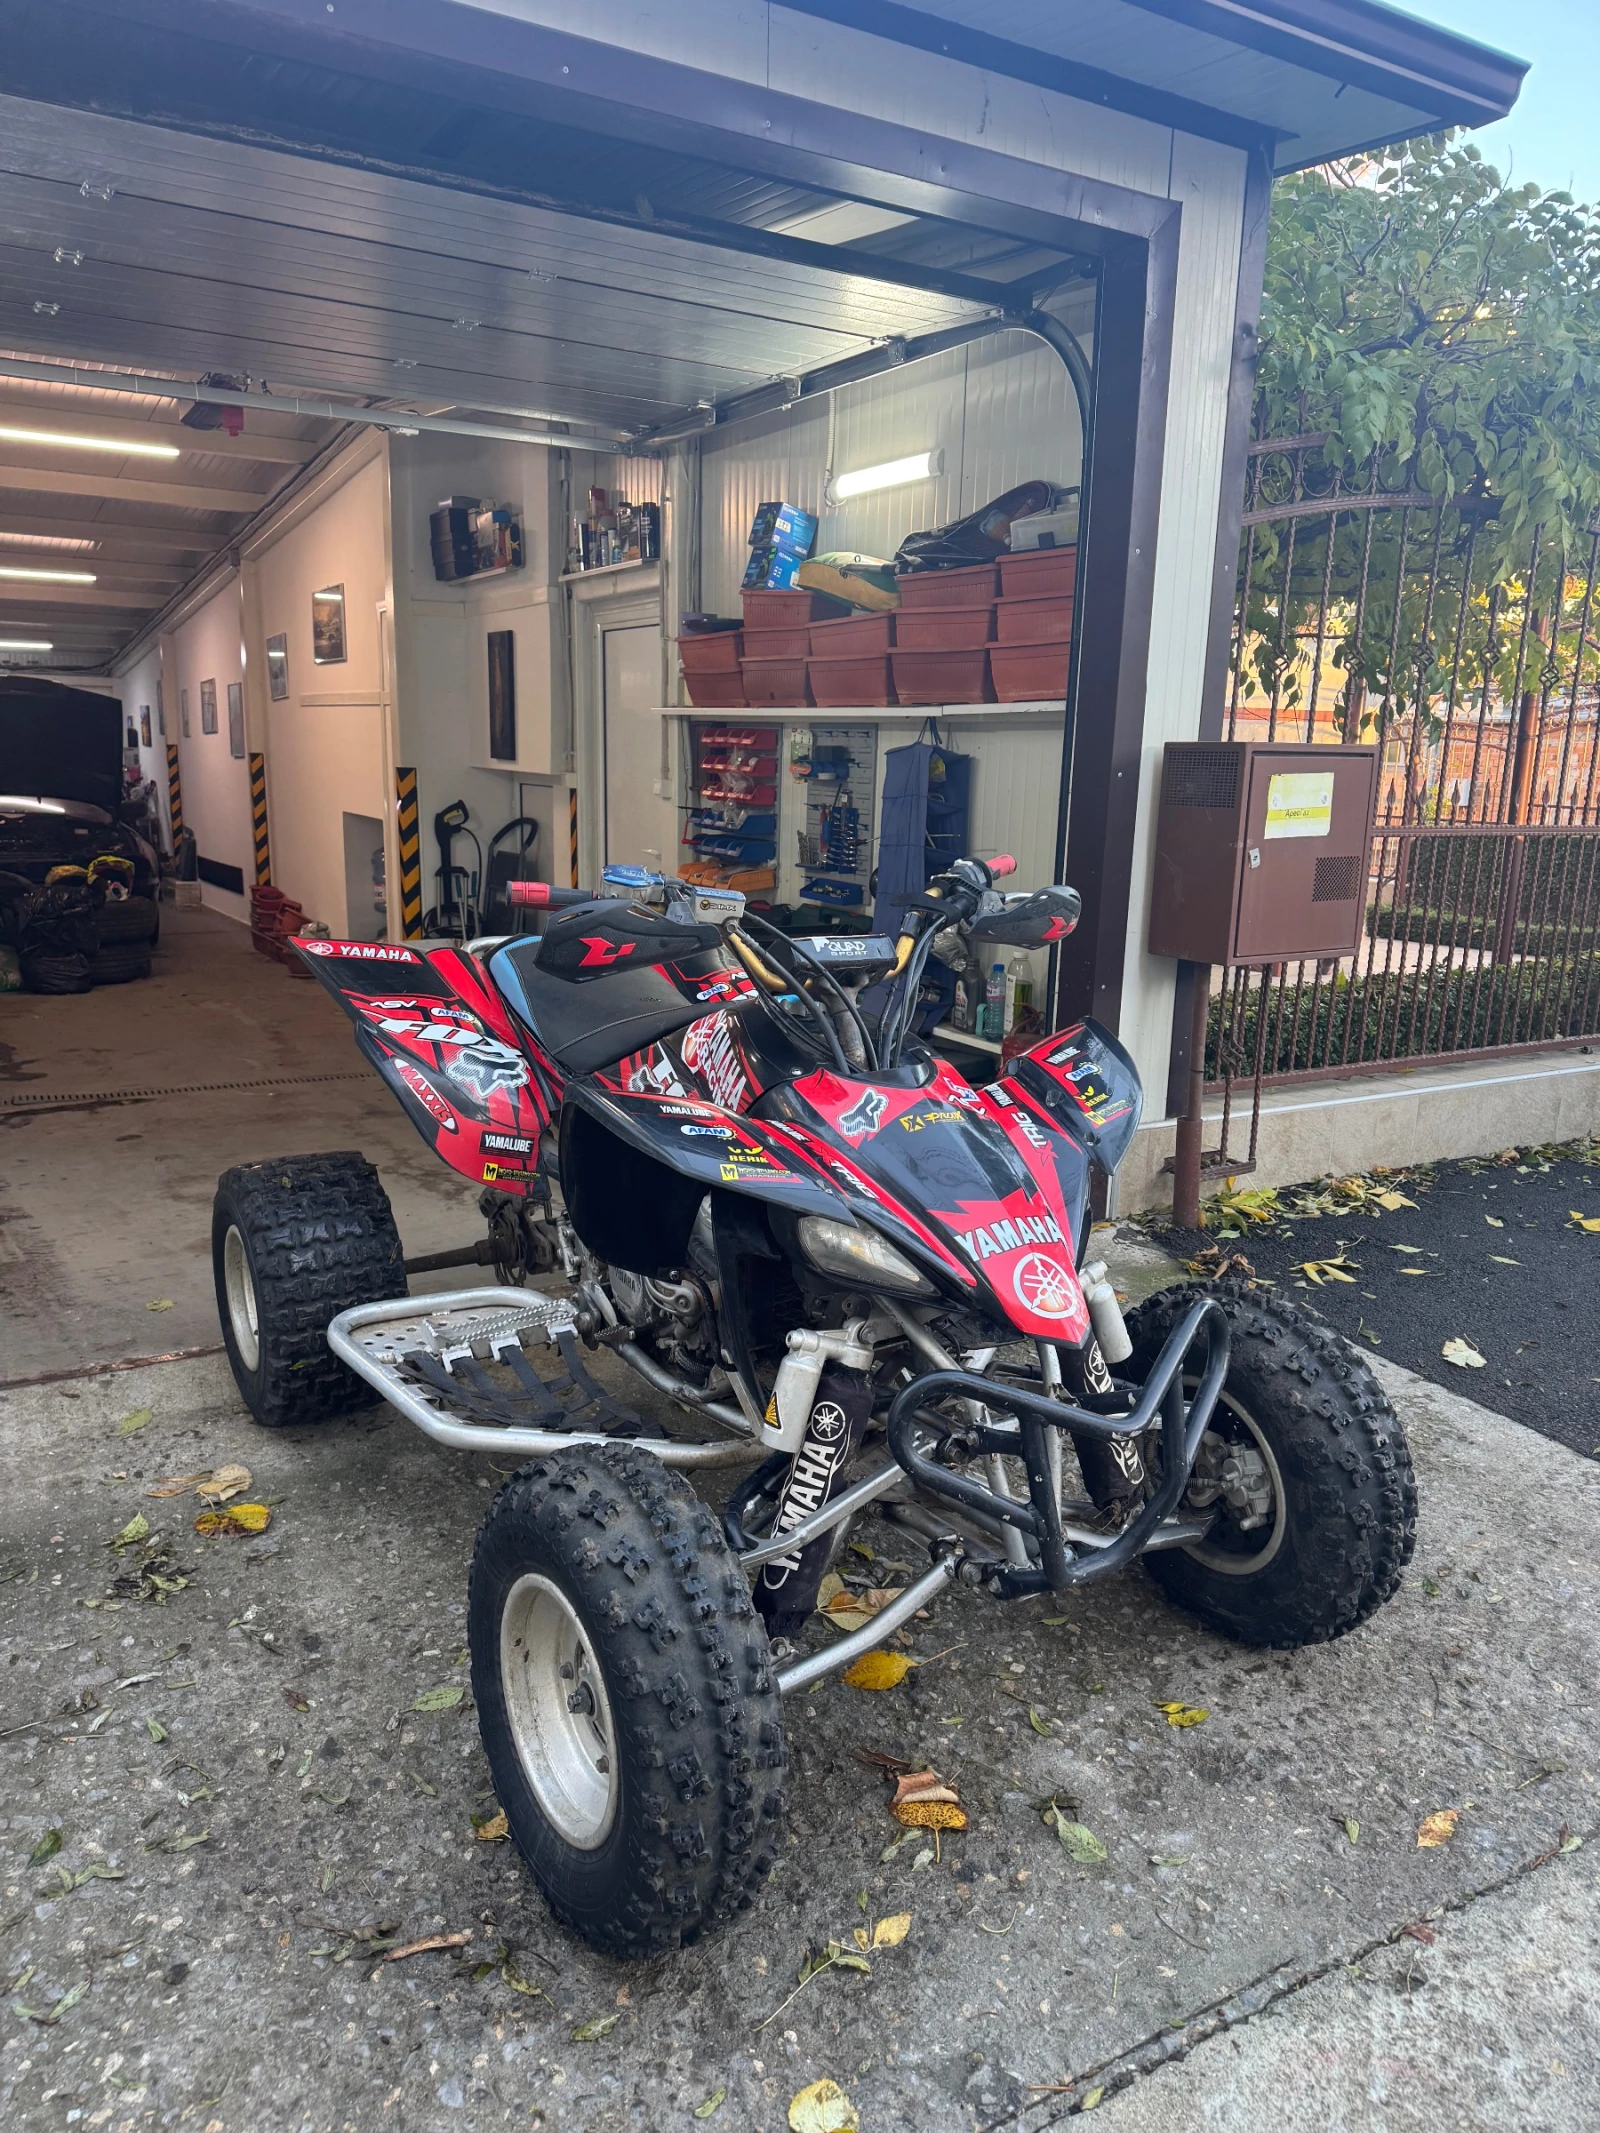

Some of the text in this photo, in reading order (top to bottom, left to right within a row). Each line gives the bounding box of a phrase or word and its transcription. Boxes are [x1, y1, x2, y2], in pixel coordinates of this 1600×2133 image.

[340, 945, 412, 962] YAMAHA
[828, 941, 866, 952] QUAD
[701, 984, 726, 998] AFAM
[437, 1009, 470, 1020] AFAM
[400, 1063, 452, 1124] MAXXIS
[660, 1105, 712, 1117] YAMALUBE
[688, 1127, 727, 1136] AFAM
[484, 1134, 532, 1153] YAMALUBE
[728, 1155, 769, 1163] BERIK
[953, 1215, 1063, 1262] YAMAHA
[767, 1440, 837, 1571] YMAHA
